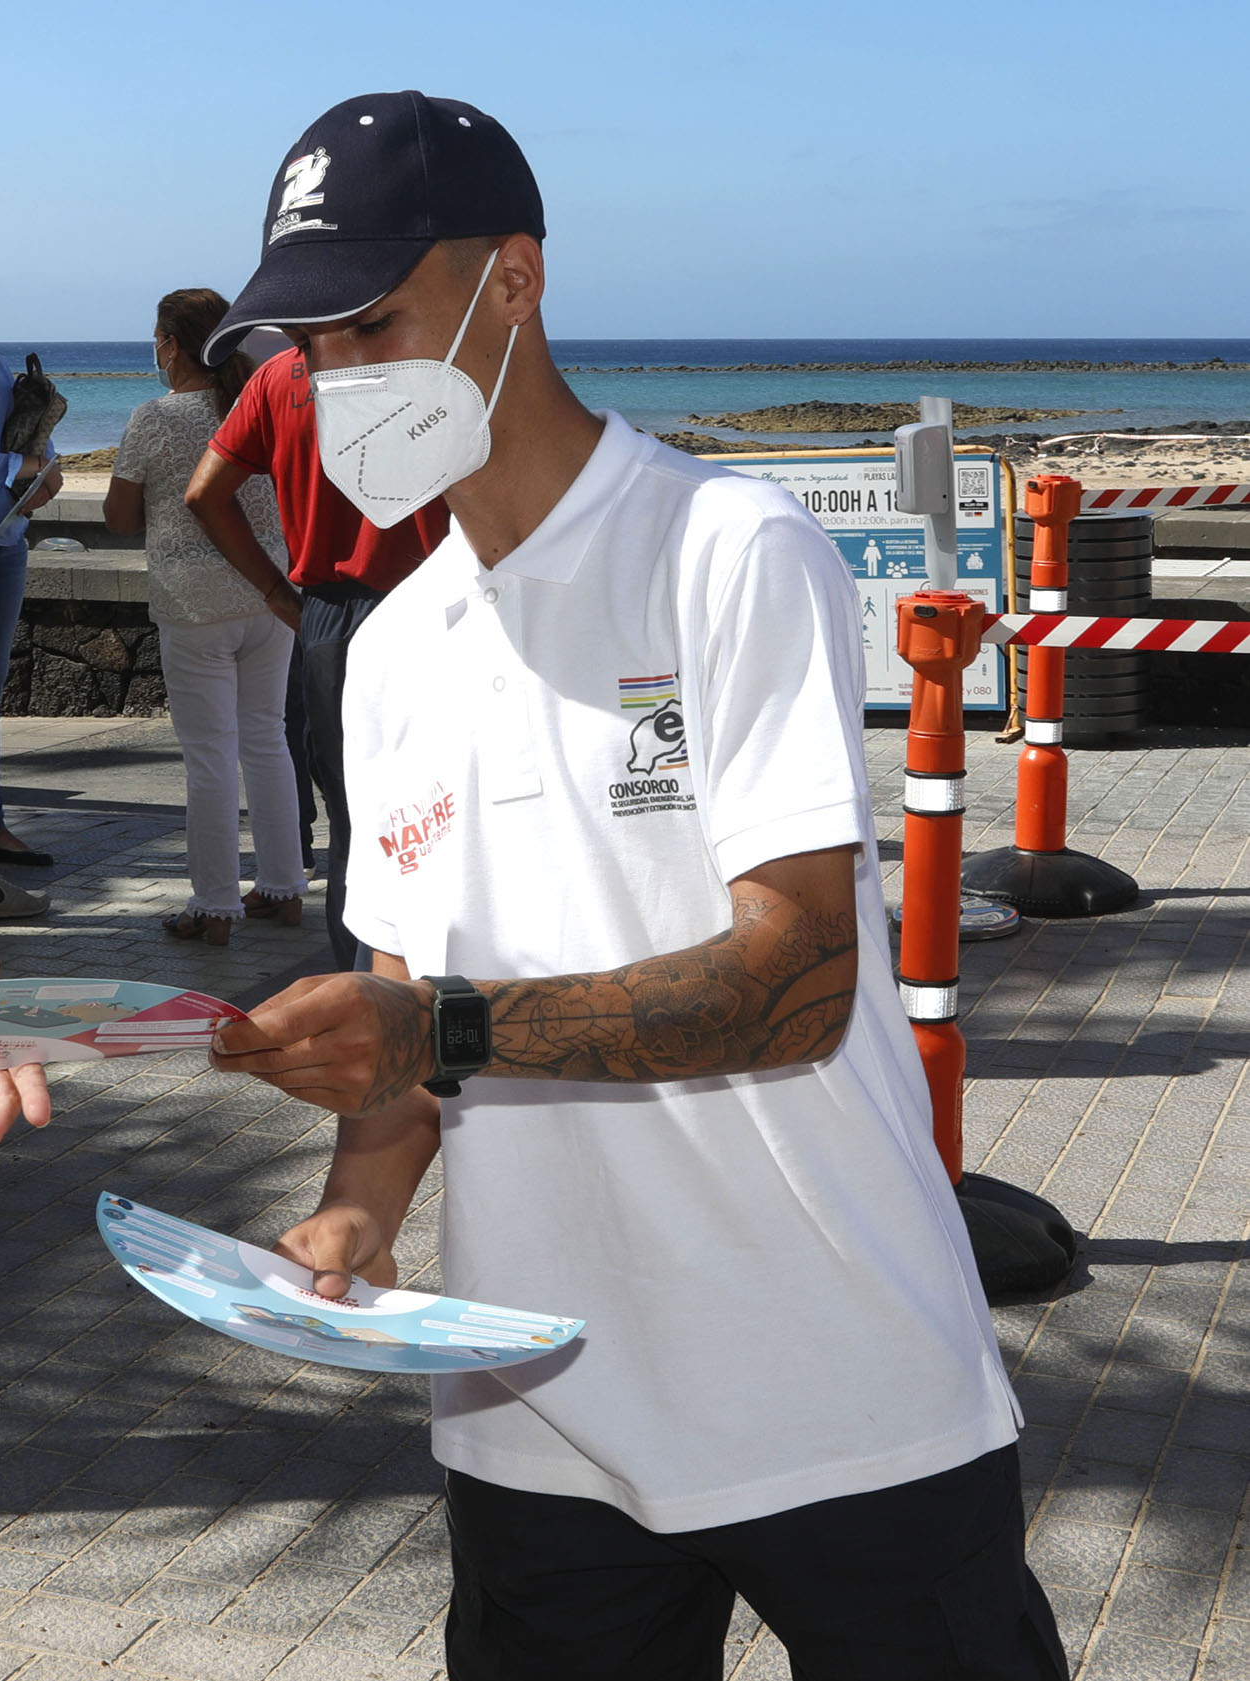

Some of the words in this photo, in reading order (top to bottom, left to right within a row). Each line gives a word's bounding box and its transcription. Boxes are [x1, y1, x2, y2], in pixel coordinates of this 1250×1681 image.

[406, 406, 448, 441] KN95
[863, 472, 886, 481] PLAYAS
[802, 489, 861, 513] 10:00H
[867, 489, 878, 513] A
[890, 517, 909, 526] para
[973, 686, 992, 695] 080
[609, 779, 679, 799] CONSORCIO
